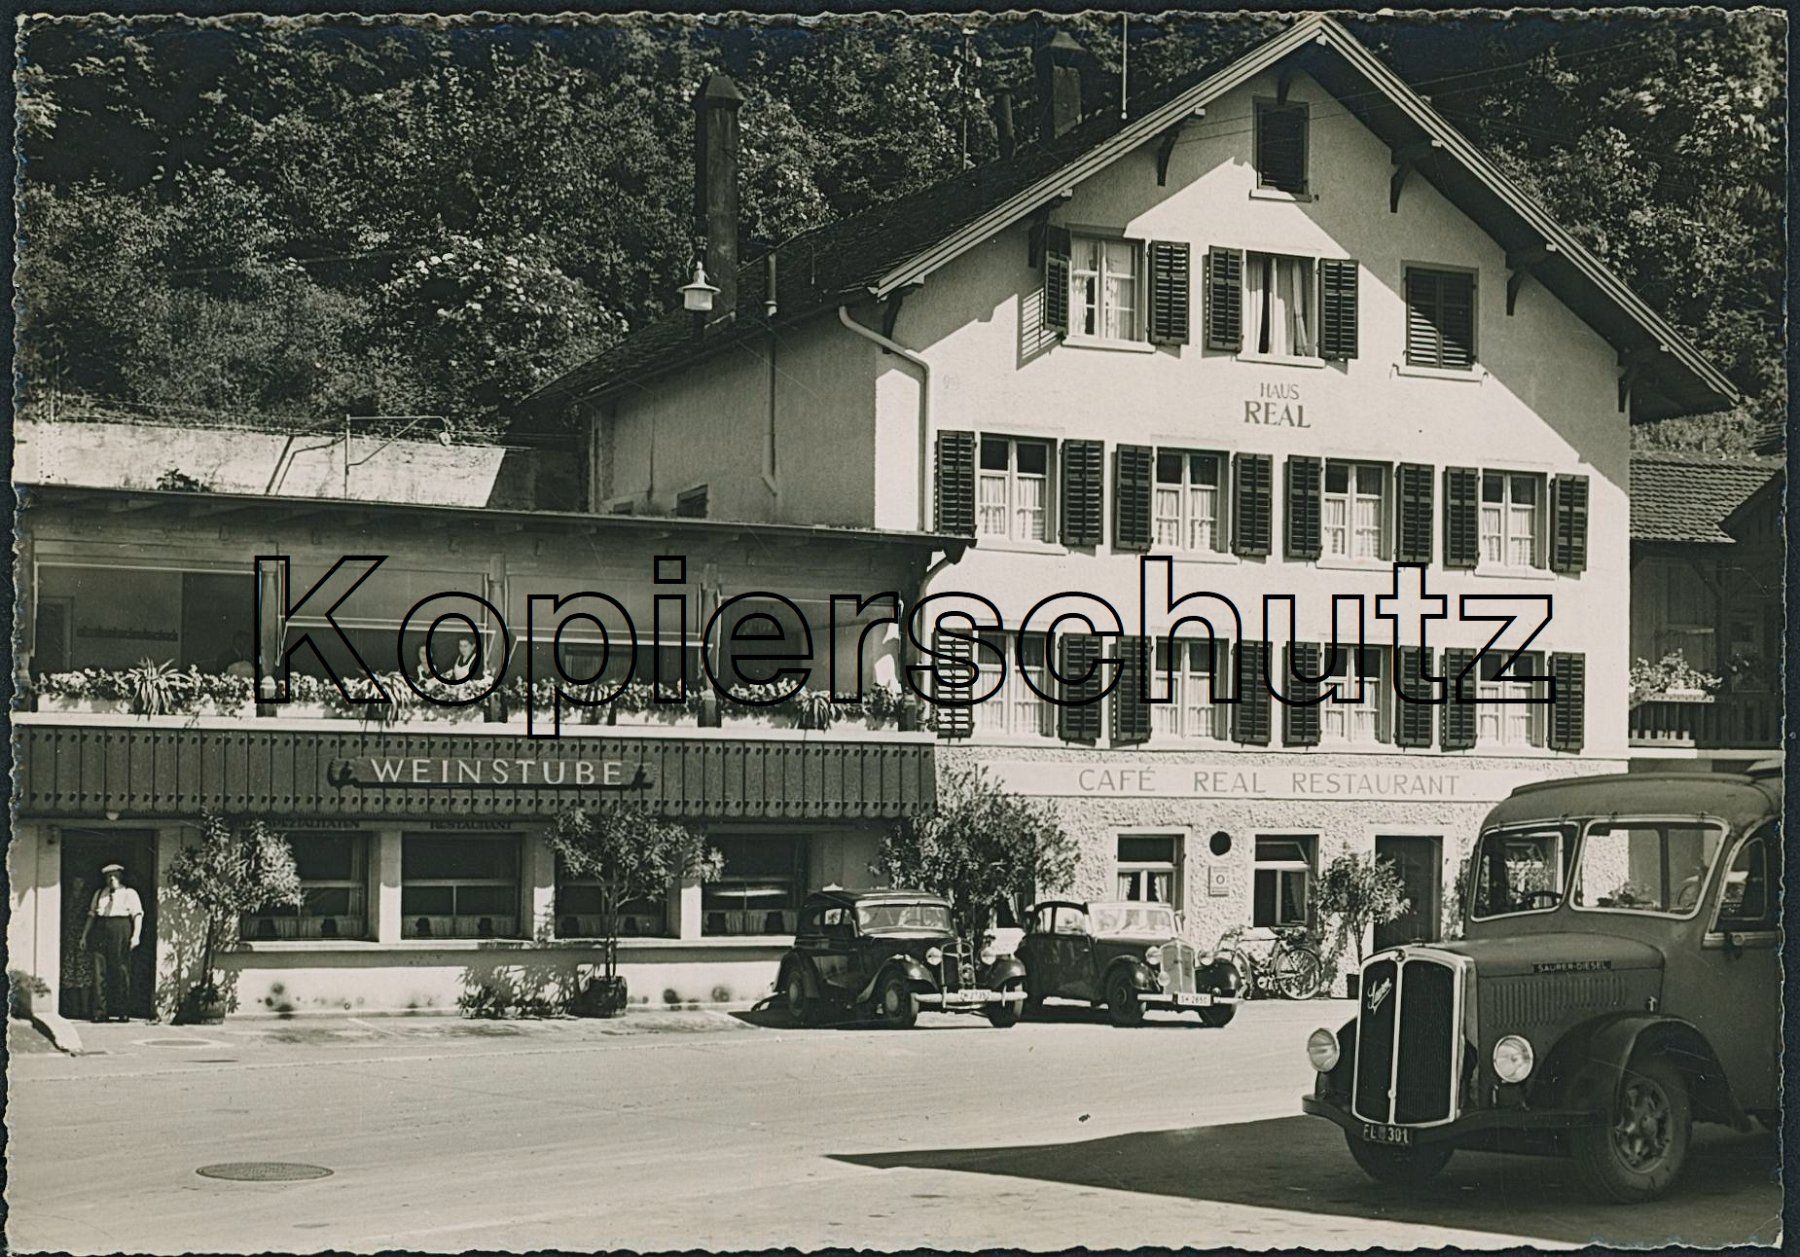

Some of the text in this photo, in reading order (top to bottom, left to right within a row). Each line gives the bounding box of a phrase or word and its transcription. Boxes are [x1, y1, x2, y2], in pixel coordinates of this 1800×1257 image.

[1260, 381, 1300, 400] HAUS
[1243, 400, 1312, 429] REAL
[370, 758, 623, 786] WEINSTUBE
[1078, 765, 1460, 797] CAFÉ REAL RESTAURANT
[429, 820, 513, 831] RESTAURANT
[1387, 1126, 1409, 1144] 301
